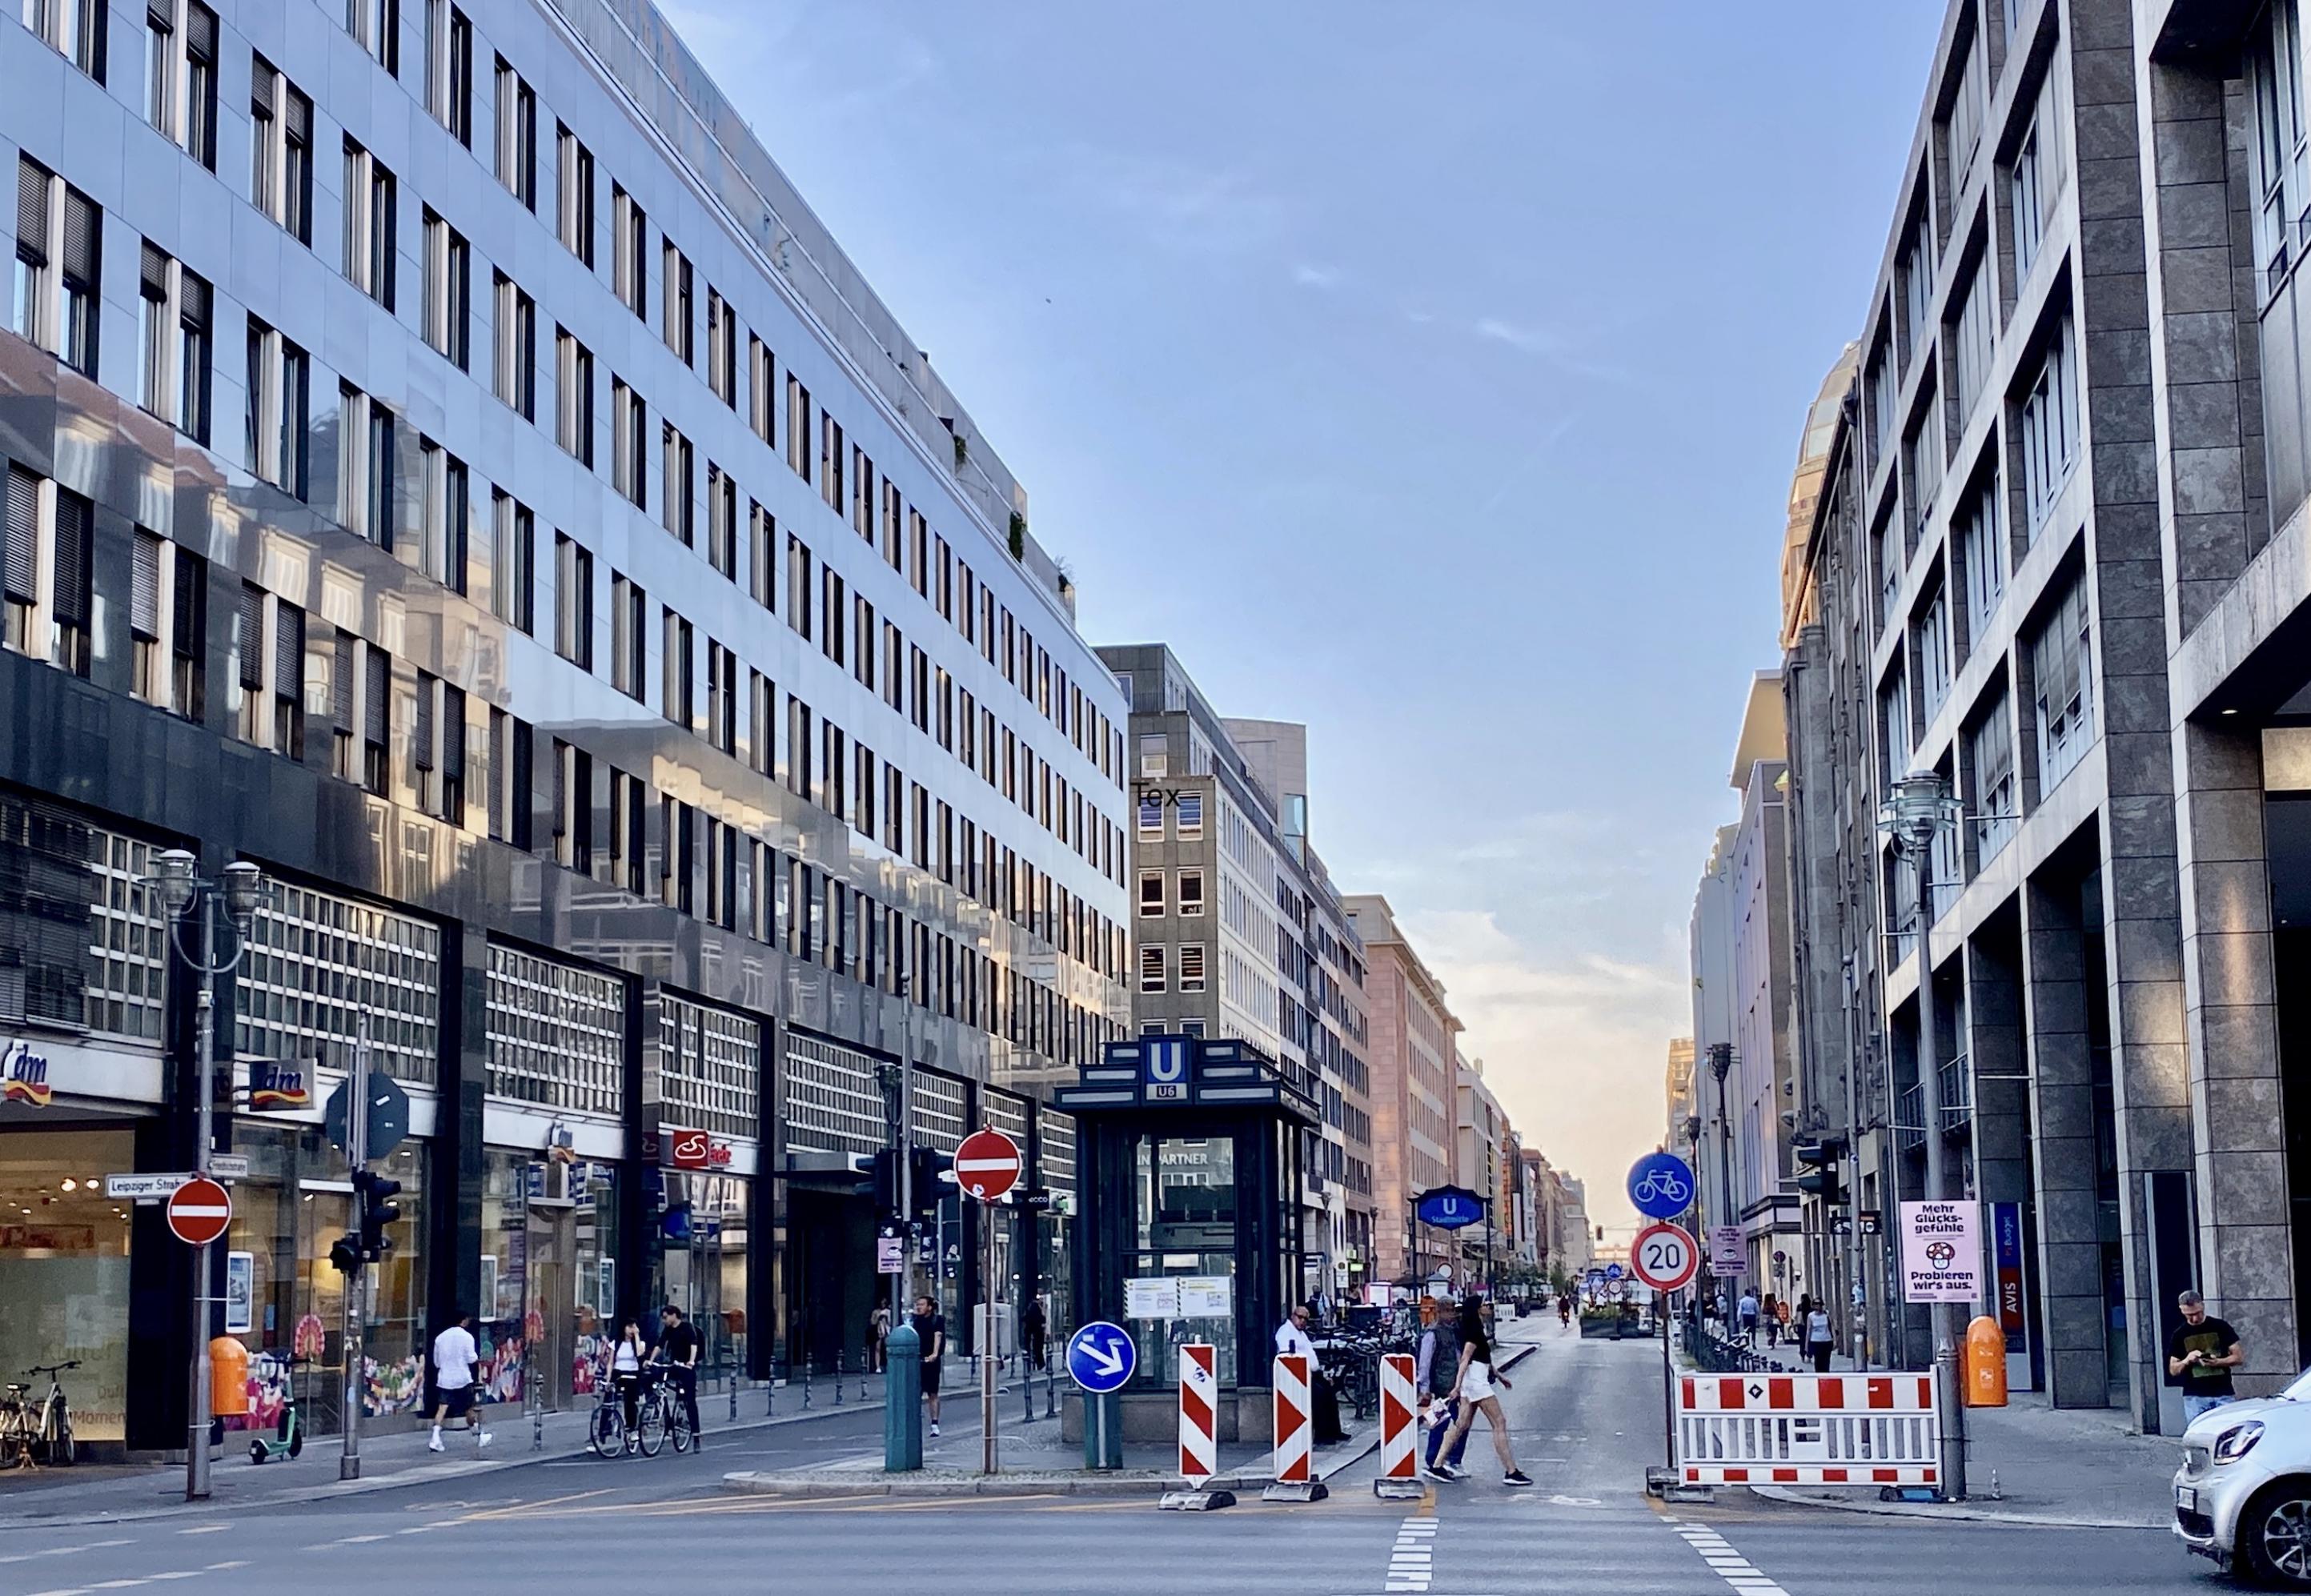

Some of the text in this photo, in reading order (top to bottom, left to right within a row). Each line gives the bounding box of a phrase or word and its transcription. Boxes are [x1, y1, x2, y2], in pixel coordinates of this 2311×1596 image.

[14, 1044, 46, 1082] dm
[1150, 1042, 1182, 1082] U
[265, 1066, 302, 1089] dm
[1158, 1086, 1175, 1097] U6
[1159, 1153, 1207, 1165] ARTNER
[111, 1177, 182, 1193] Leipziger Straß
[1442, 1197, 1457, 1215] U
[1922, 1205, 1955, 1213] Mehr
[1915, 1213, 1963, 1223] Glücks-
[1915, 1224, 1964, 1234] gefühle
[2004, 1216, 2013, 1246] Budget
[1647, 1244, 1680, 1270] 20
[1911, 1271, 1973, 1281] Probieren
[1913, 1281, 1972, 1290] wir's aus.
[2005, 1282, 2017, 1313] AVIS
